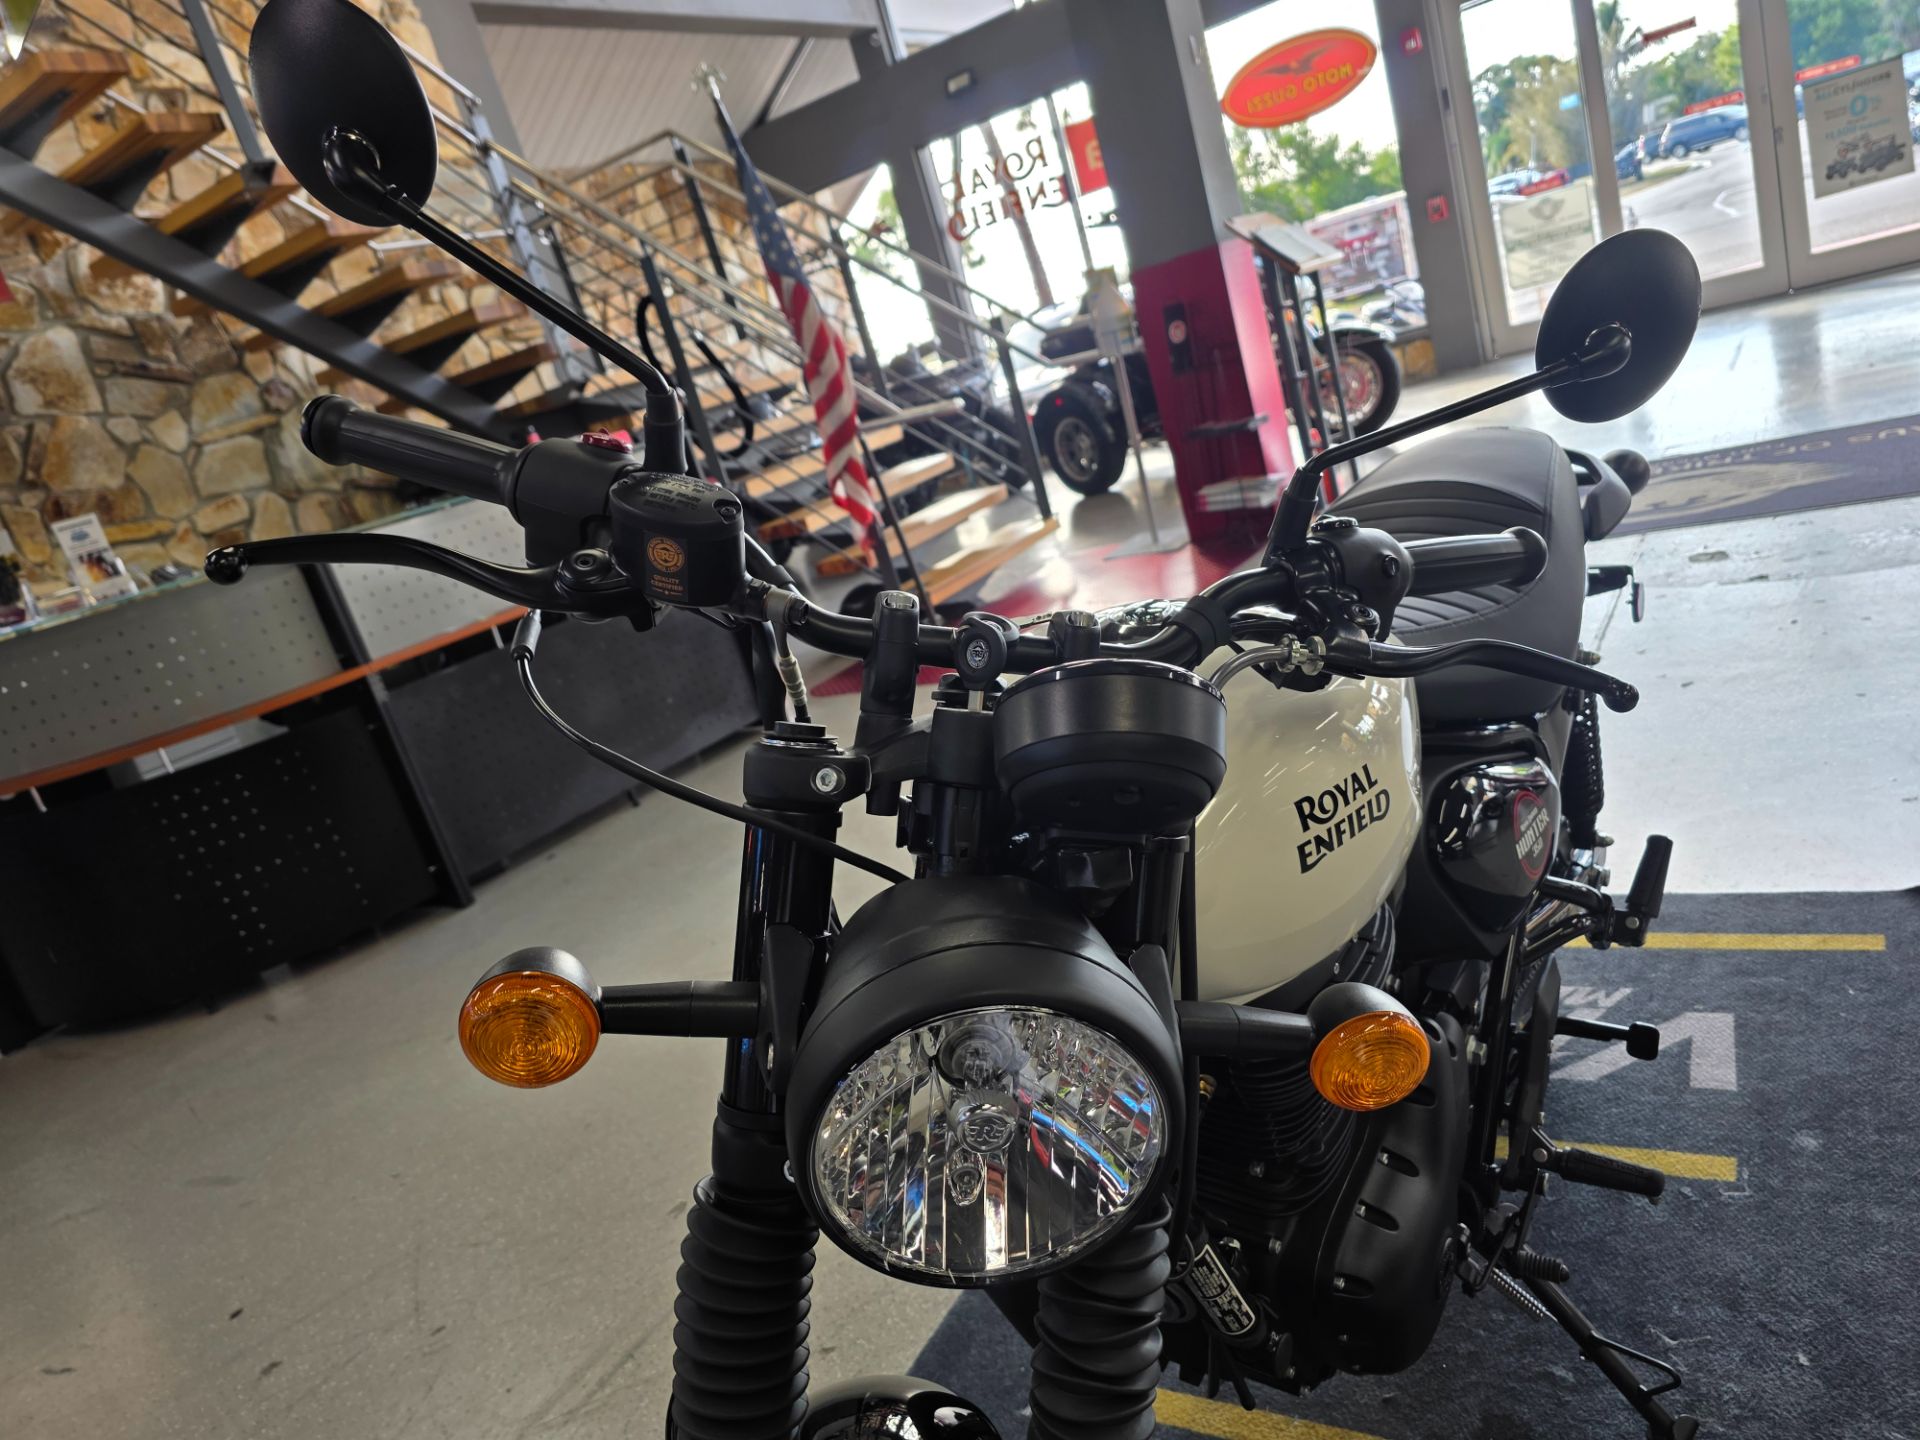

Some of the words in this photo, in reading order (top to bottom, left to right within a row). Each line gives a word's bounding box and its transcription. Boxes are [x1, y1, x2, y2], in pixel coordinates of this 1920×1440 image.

[1293, 763, 1378, 833] ROYAL
[1296, 788, 1391, 874] ENFIELD
[1515, 807, 1550, 860] HUNTER
